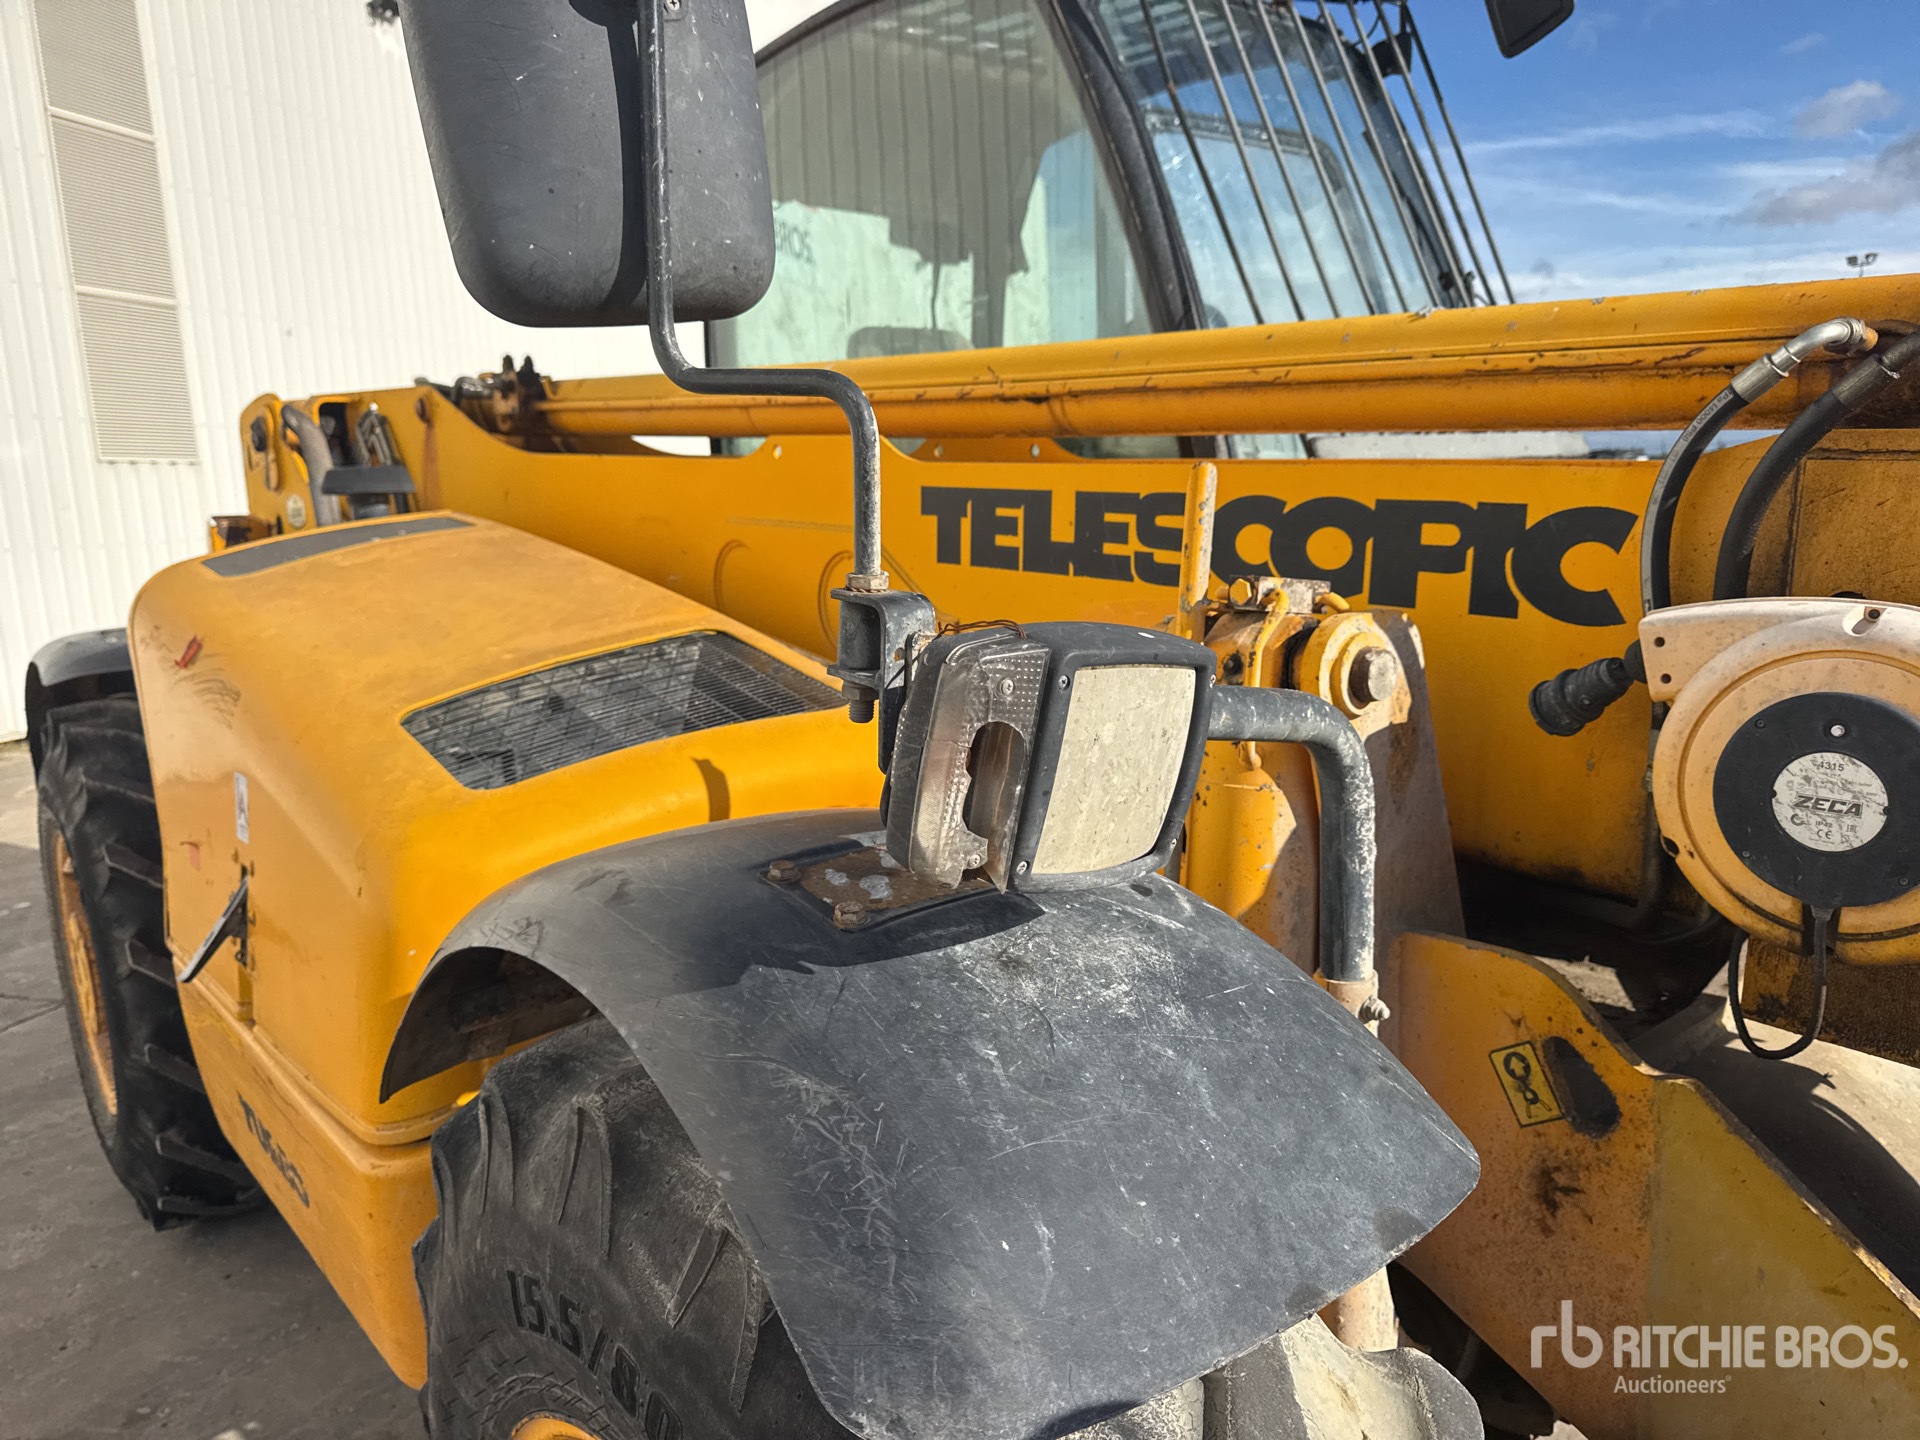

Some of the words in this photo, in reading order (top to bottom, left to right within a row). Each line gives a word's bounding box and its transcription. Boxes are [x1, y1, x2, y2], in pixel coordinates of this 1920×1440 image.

[920, 485, 1641, 628] TELESCOPIC
[1819, 761, 1845, 772] 4315
[1793, 795, 1862, 818] ZECA
